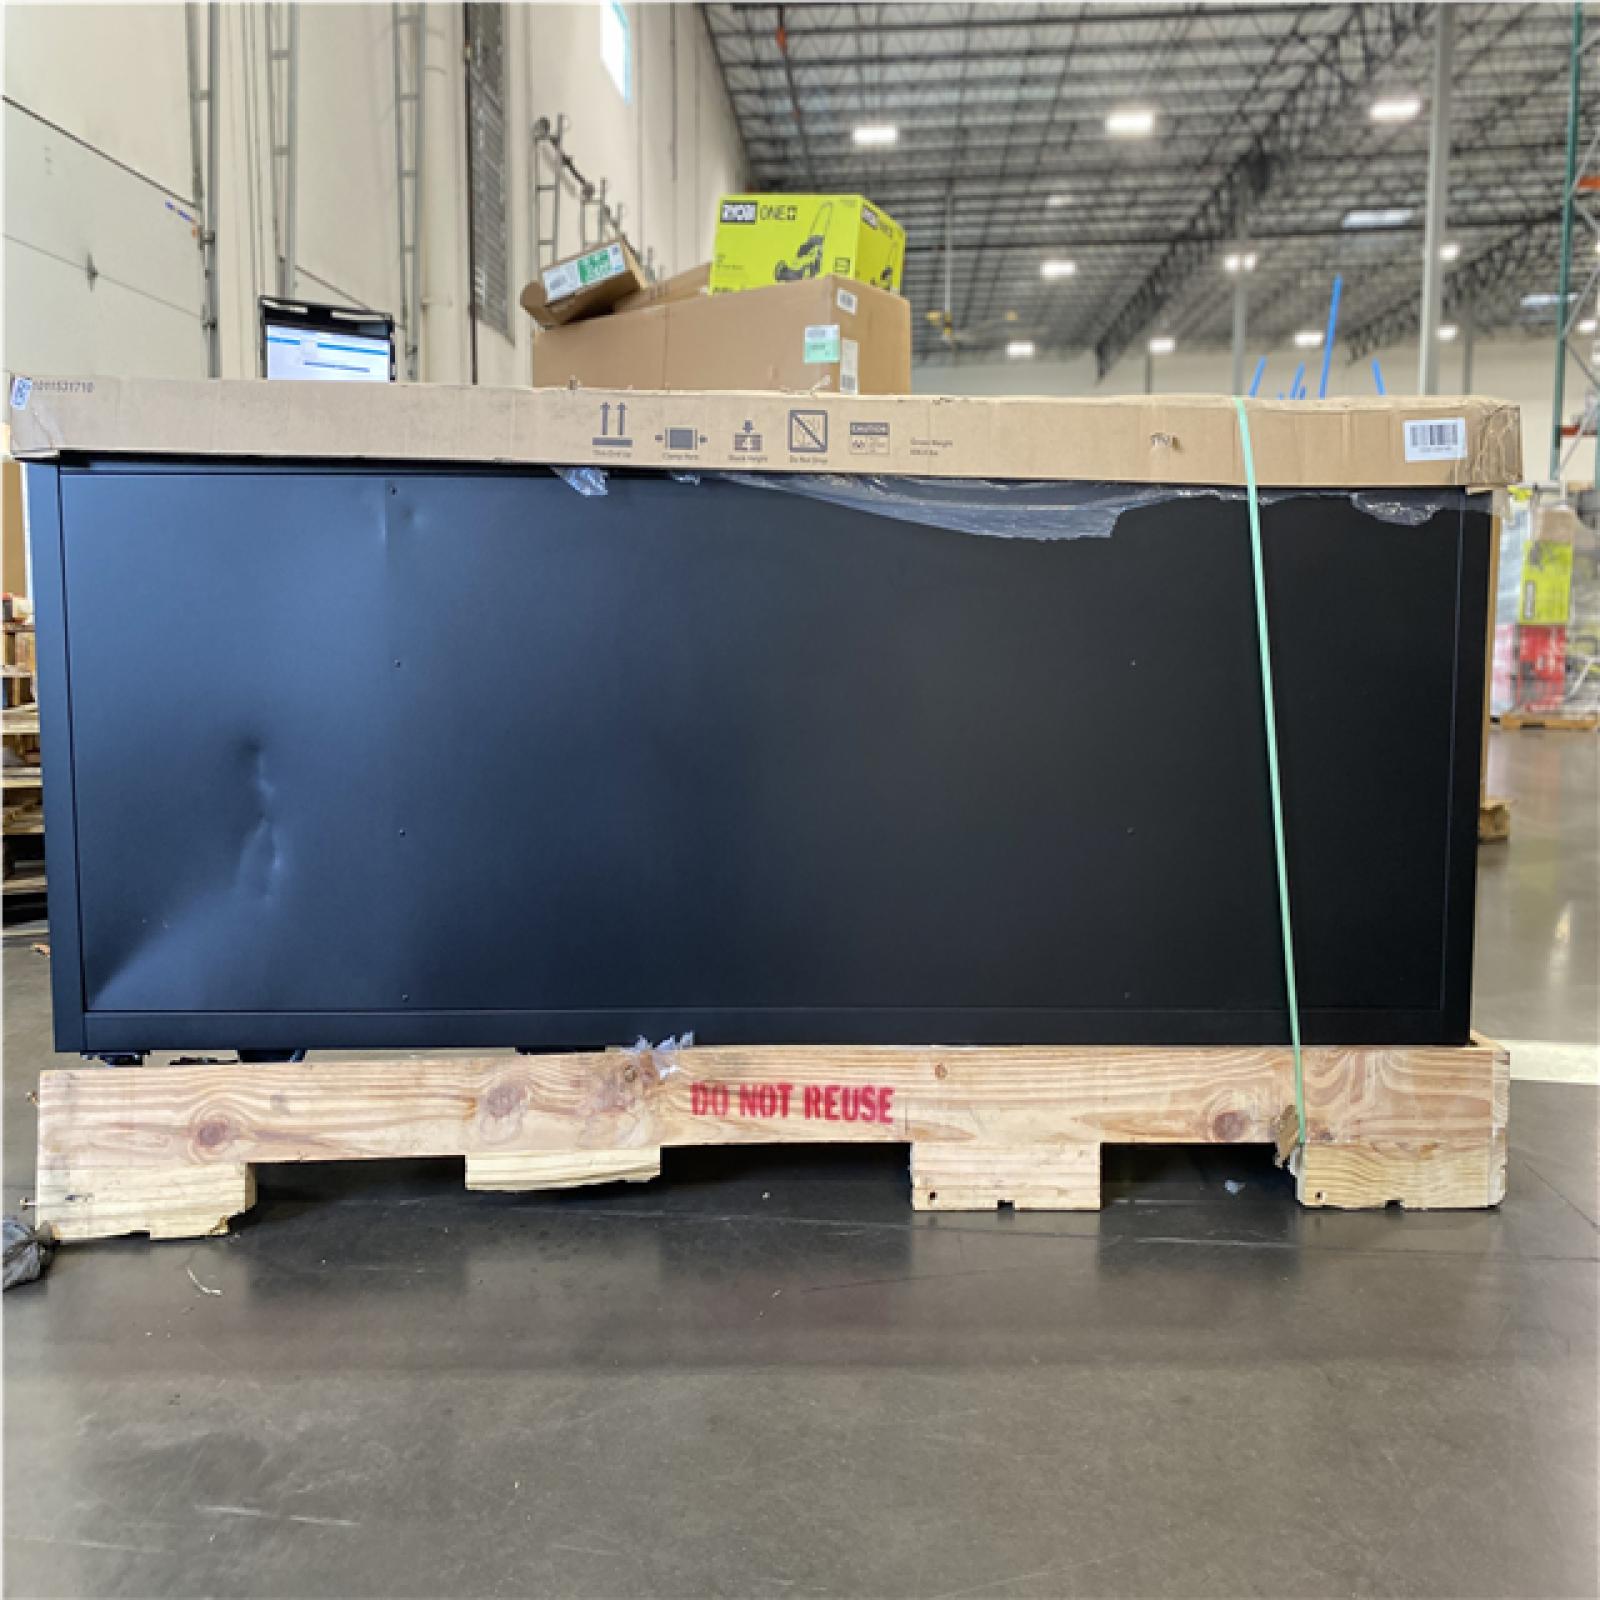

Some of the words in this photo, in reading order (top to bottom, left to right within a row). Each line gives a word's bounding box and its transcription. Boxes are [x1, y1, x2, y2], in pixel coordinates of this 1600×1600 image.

[690, 1082, 728, 1116] DO
[739, 1082, 793, 1118] NOT
[803, 1084, 896, 1124] REUSE
